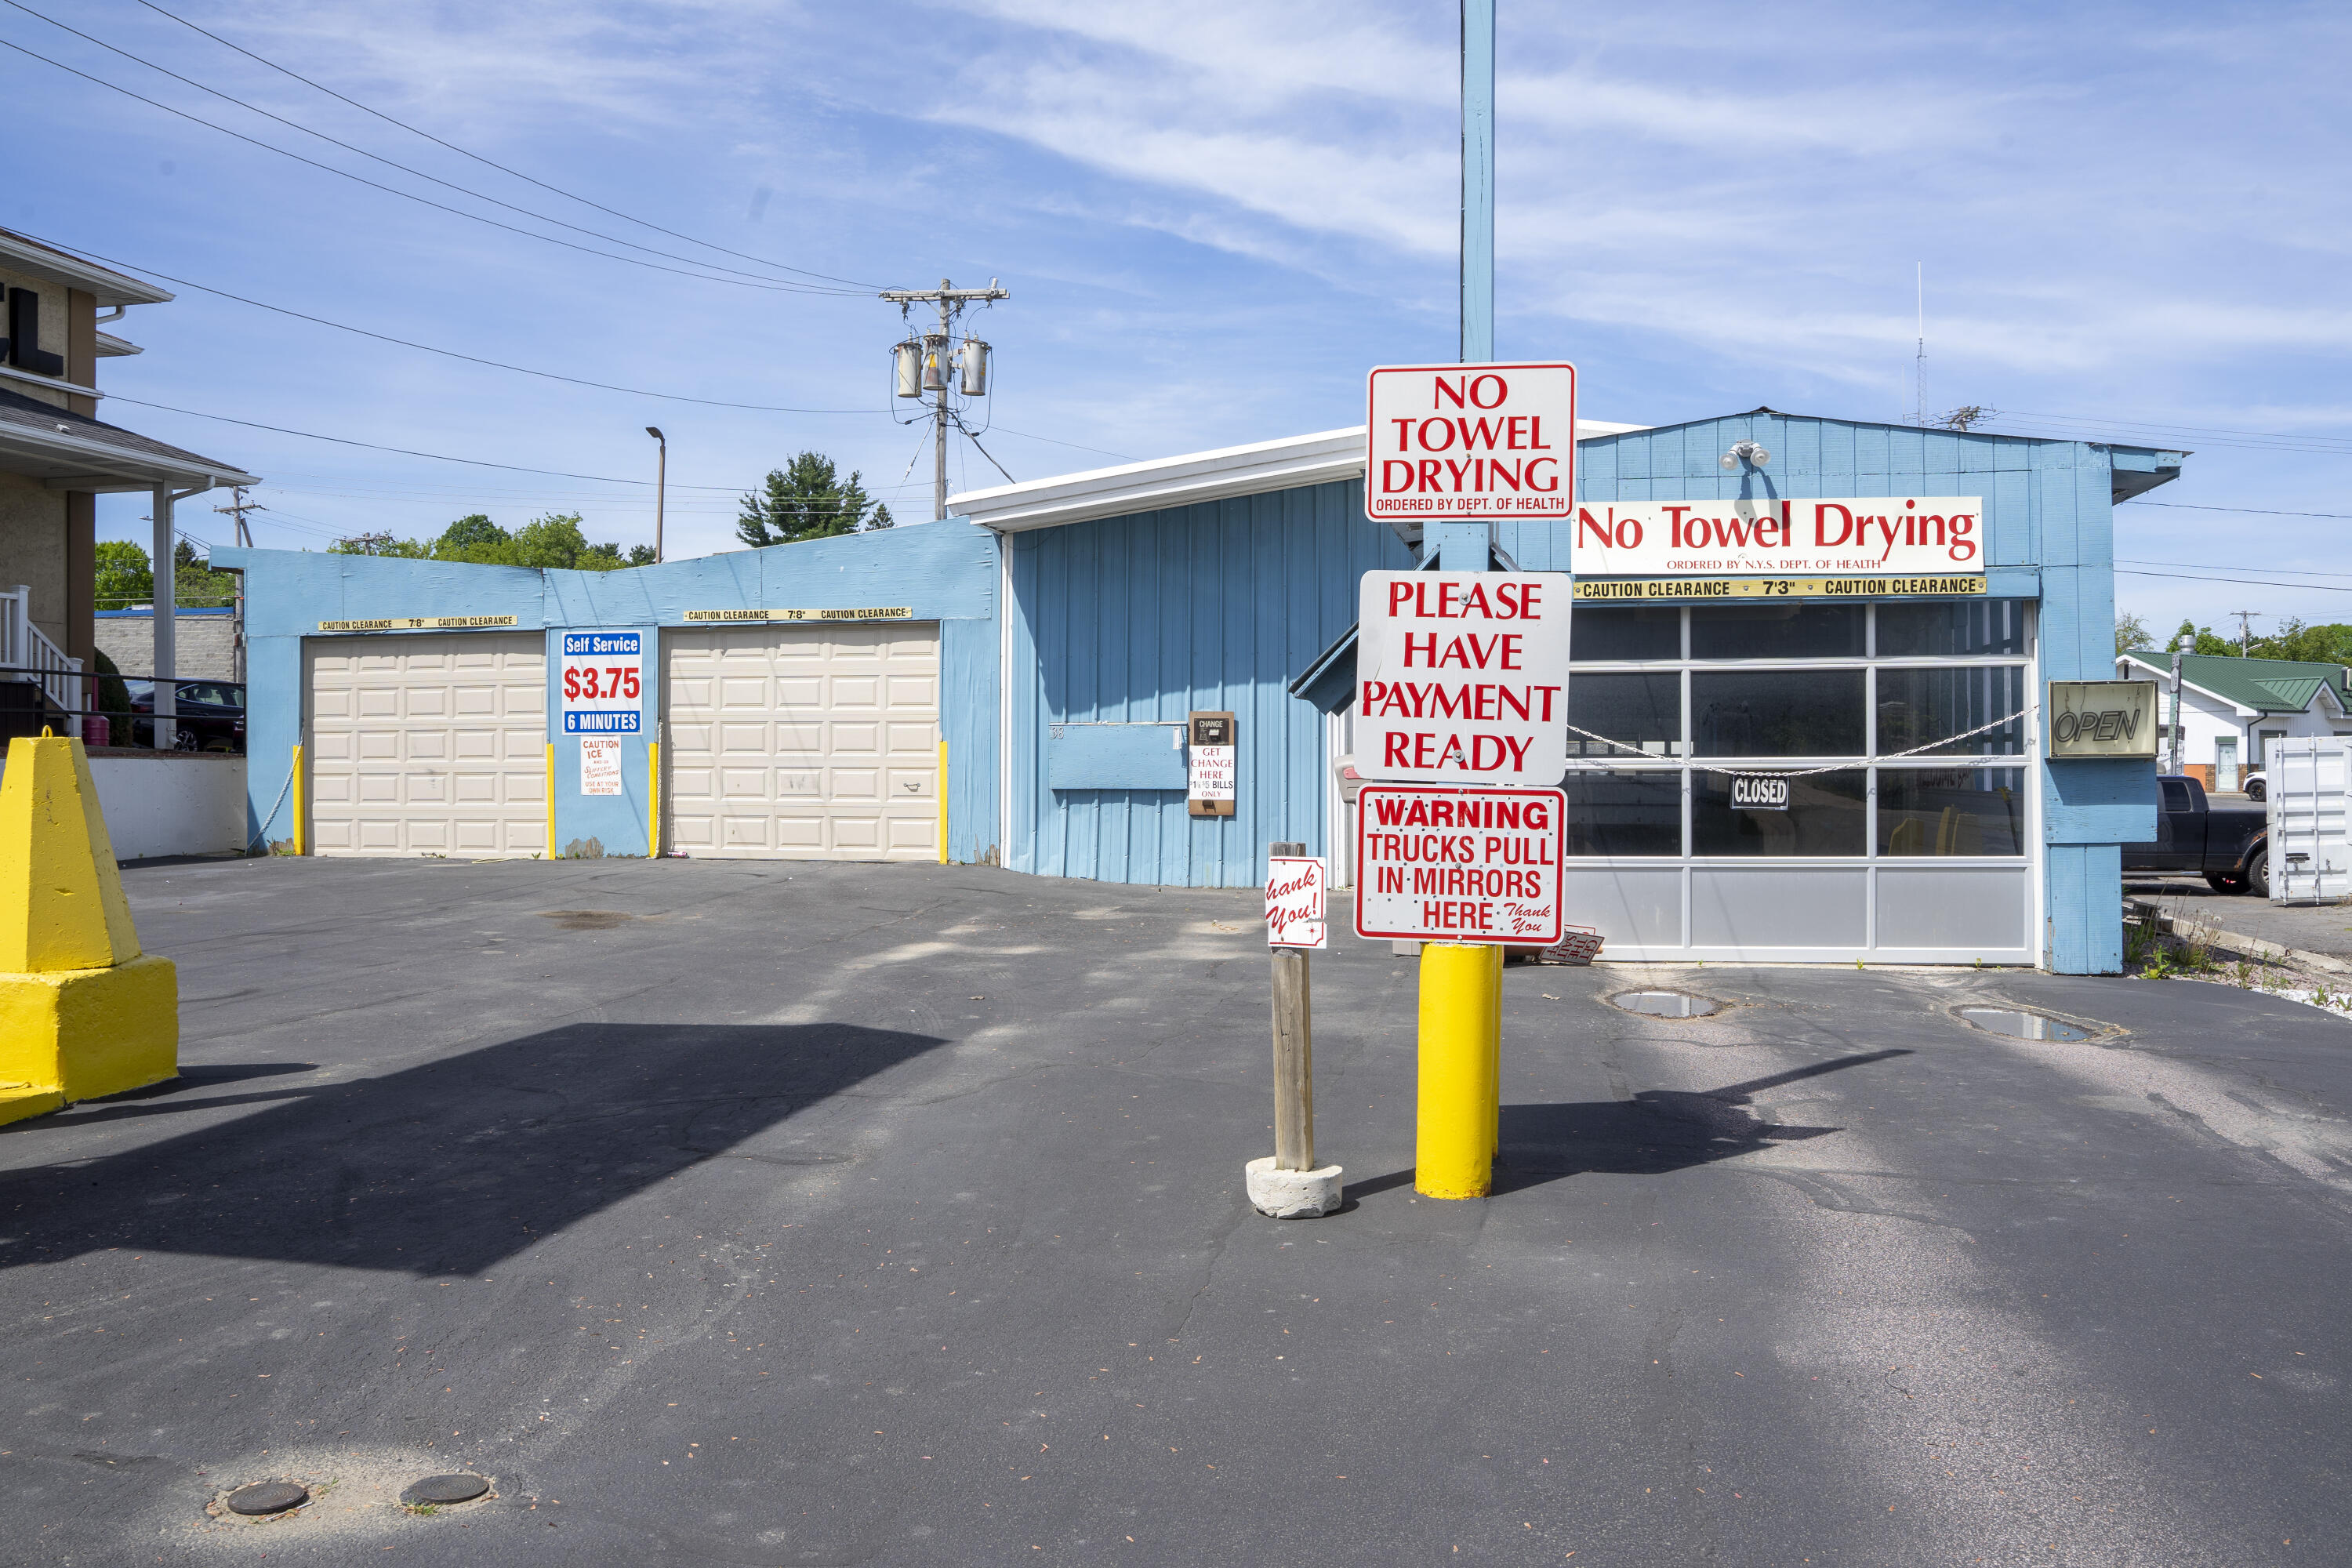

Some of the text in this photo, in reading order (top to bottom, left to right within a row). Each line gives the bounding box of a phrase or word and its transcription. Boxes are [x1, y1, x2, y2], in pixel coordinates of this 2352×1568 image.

[1434, 374, 1508, 409] NO
[1392, 416, 1551, 452] TOWEL
[1382, 457, 1559, 493] DRYING
[1376, 497, 1565, 511] ORDERED BY DEPT. OF HEALTH
[1578, 499, 1976, 561] No Towel Drying
[1667, 559, 1881, 569] ORDERED BY N.Y.S. DEPT. OF HEALTH
[1388, 582, 1542, 620] PLEASE
[1584, 578, 1976, 597] CAUTION CLEARANCE 7'3" CAUTION CLEARANCE
[353, 619, 392, 629] CLEARANCE
[438, 618, 467, 626] CAUTION
[470, 616, 513, 626] CLEARANCE
[688, 611, 720, 620] CAUTION
[723, 610, 769, 619] CLEARANCE
[822, 609, 855, 619] CAUTION
[858, 608, 906, 618] CLEARANCE
[566, 637, 638, 652] Self Service
[1403, 632, 1523, 670] HAVE
[564, 666, 640, 702] $3.75
[1362, 681, 1562, 723] PAYMENT
[568, 713, 637, 730] 6 MINUTES
[2055, 709, 2140, 742] OPEN
[587, 750, 602, 759] ICE
[1191, 759, 1232, 768] CHANGE
[1384, 732, 1535, 773] READY
[1200, 771, 1223, 779] HERE
[1734, 778, 1786, 803] CLOSED
[1375, 798, 1548, 829] WARNING
[1367, 833, 1554, 866] TRUCKS PULL
[1266, 865, 1317, 900] hank
[1377, 866, 1541, 898] IN MIRRORS
[1424, 900, 1551, 930] HERE Thank
[1512, 918, 1543, 935] You
[1557, 935, 1577, 959] SALT
[1568, 939, 1587, 960] THE
[1580, 939, 1598, 960] GET
